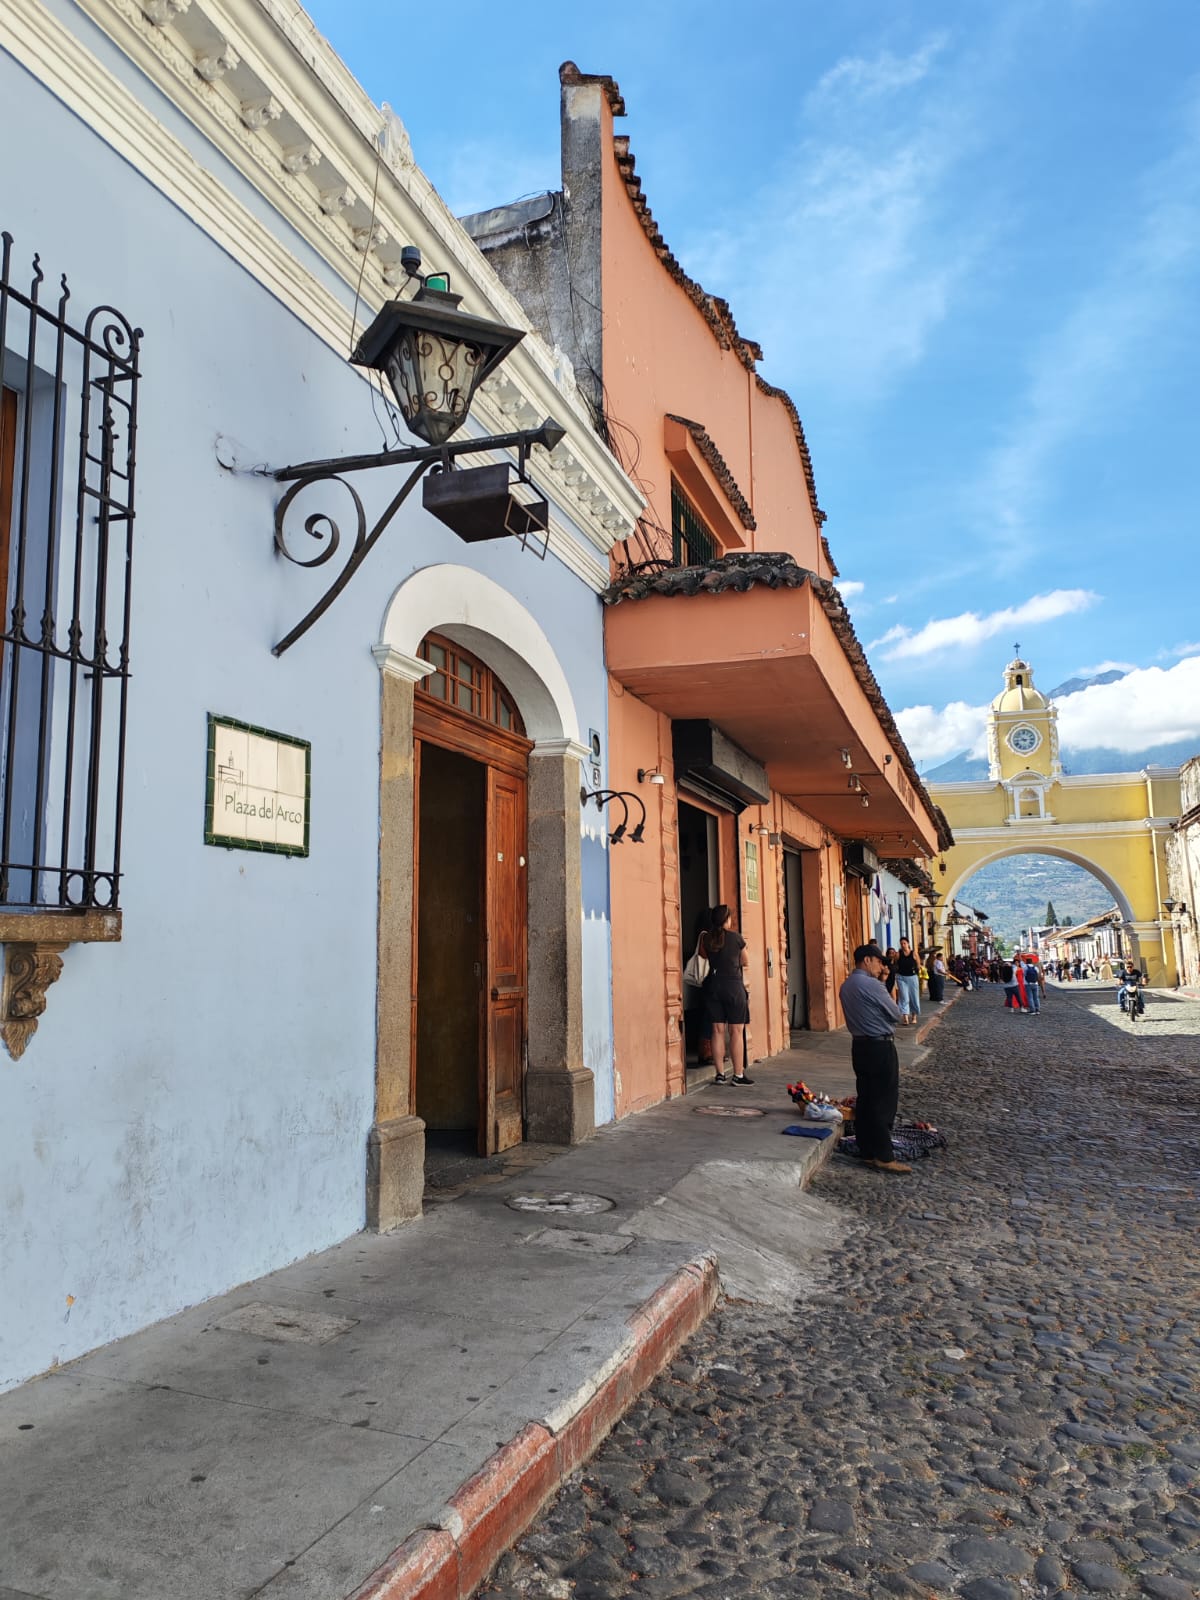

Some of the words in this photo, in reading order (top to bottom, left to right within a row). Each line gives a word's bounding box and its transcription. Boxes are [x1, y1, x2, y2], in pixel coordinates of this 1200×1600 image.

[224, 791, 256, 816] Plaza
[259, 797, 274, 819] del
[276, 805, 302, 824] Arco
